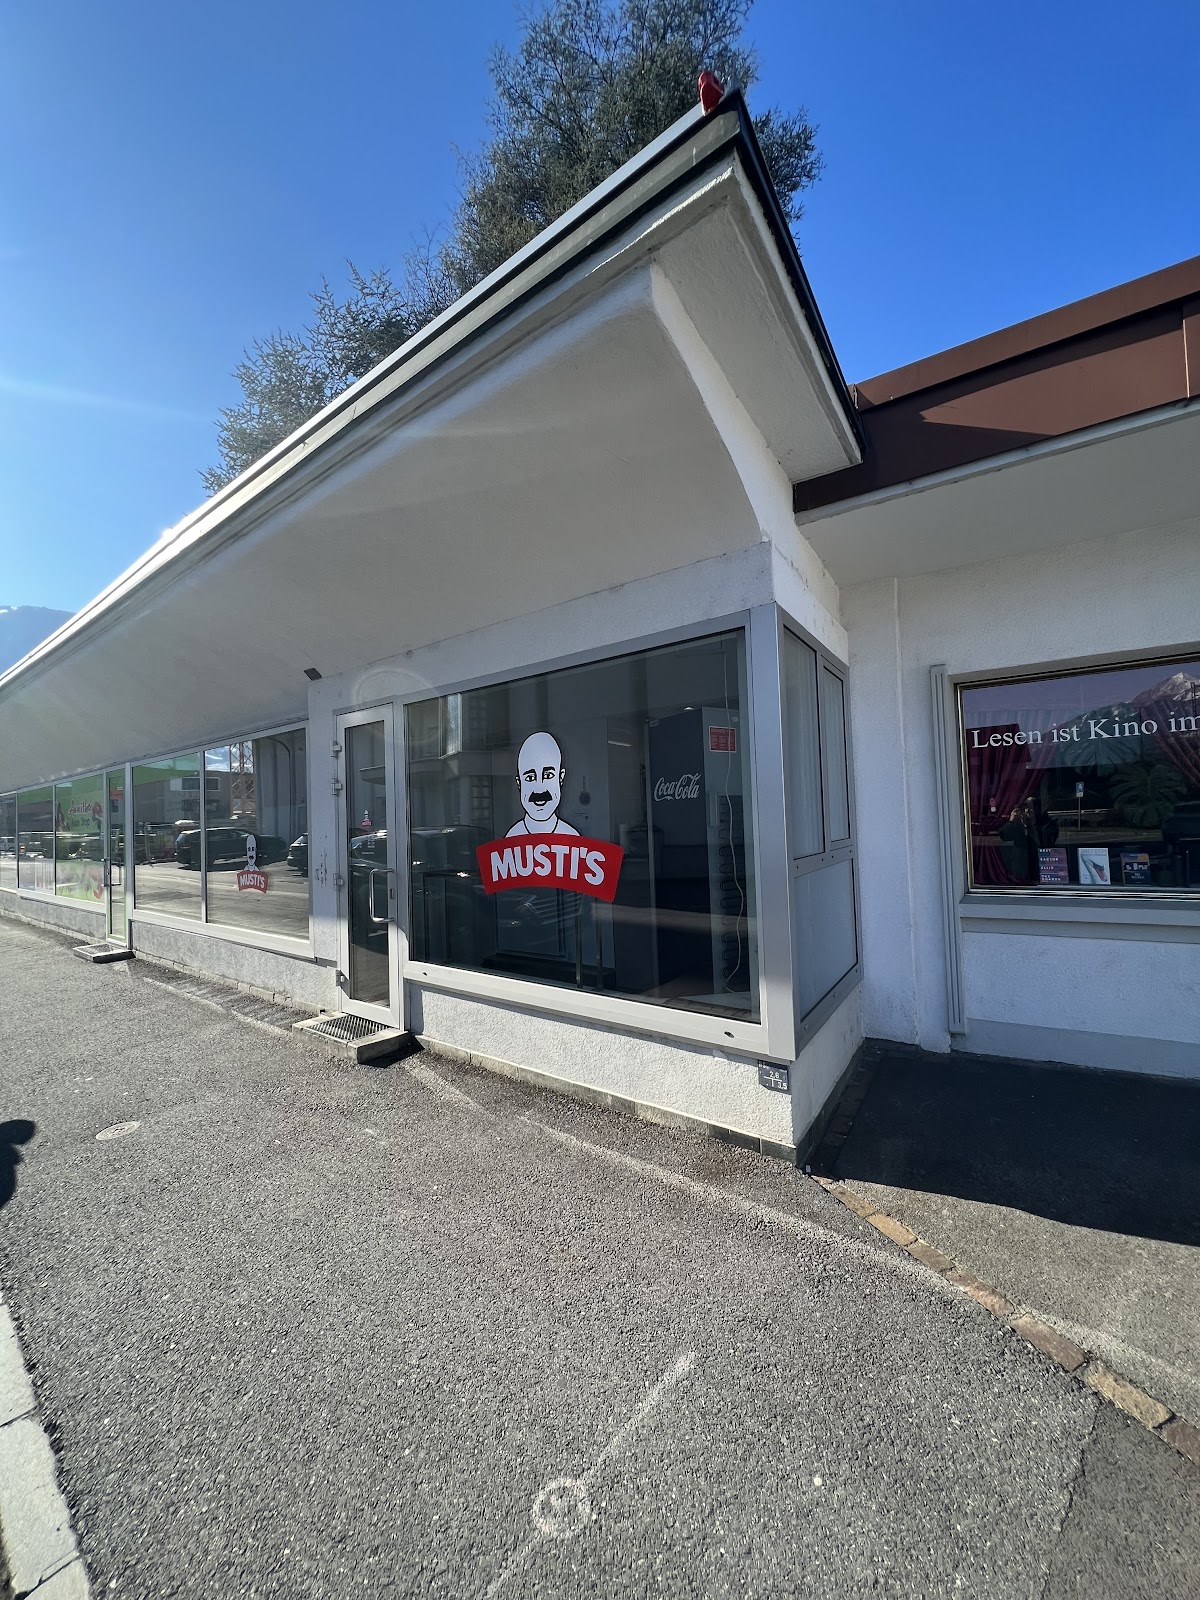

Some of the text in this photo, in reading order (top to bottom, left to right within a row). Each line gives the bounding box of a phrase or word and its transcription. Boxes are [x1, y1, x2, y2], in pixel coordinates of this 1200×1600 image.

[971, 730, 1043, 749] Lesen
[1051, 722, 1080, 743] ist
[1087, 716, 1158, 740] Kino
[239, 873, 265, 889] MUSTI'S
[490, 843, 606, 886] MUSTI'S
